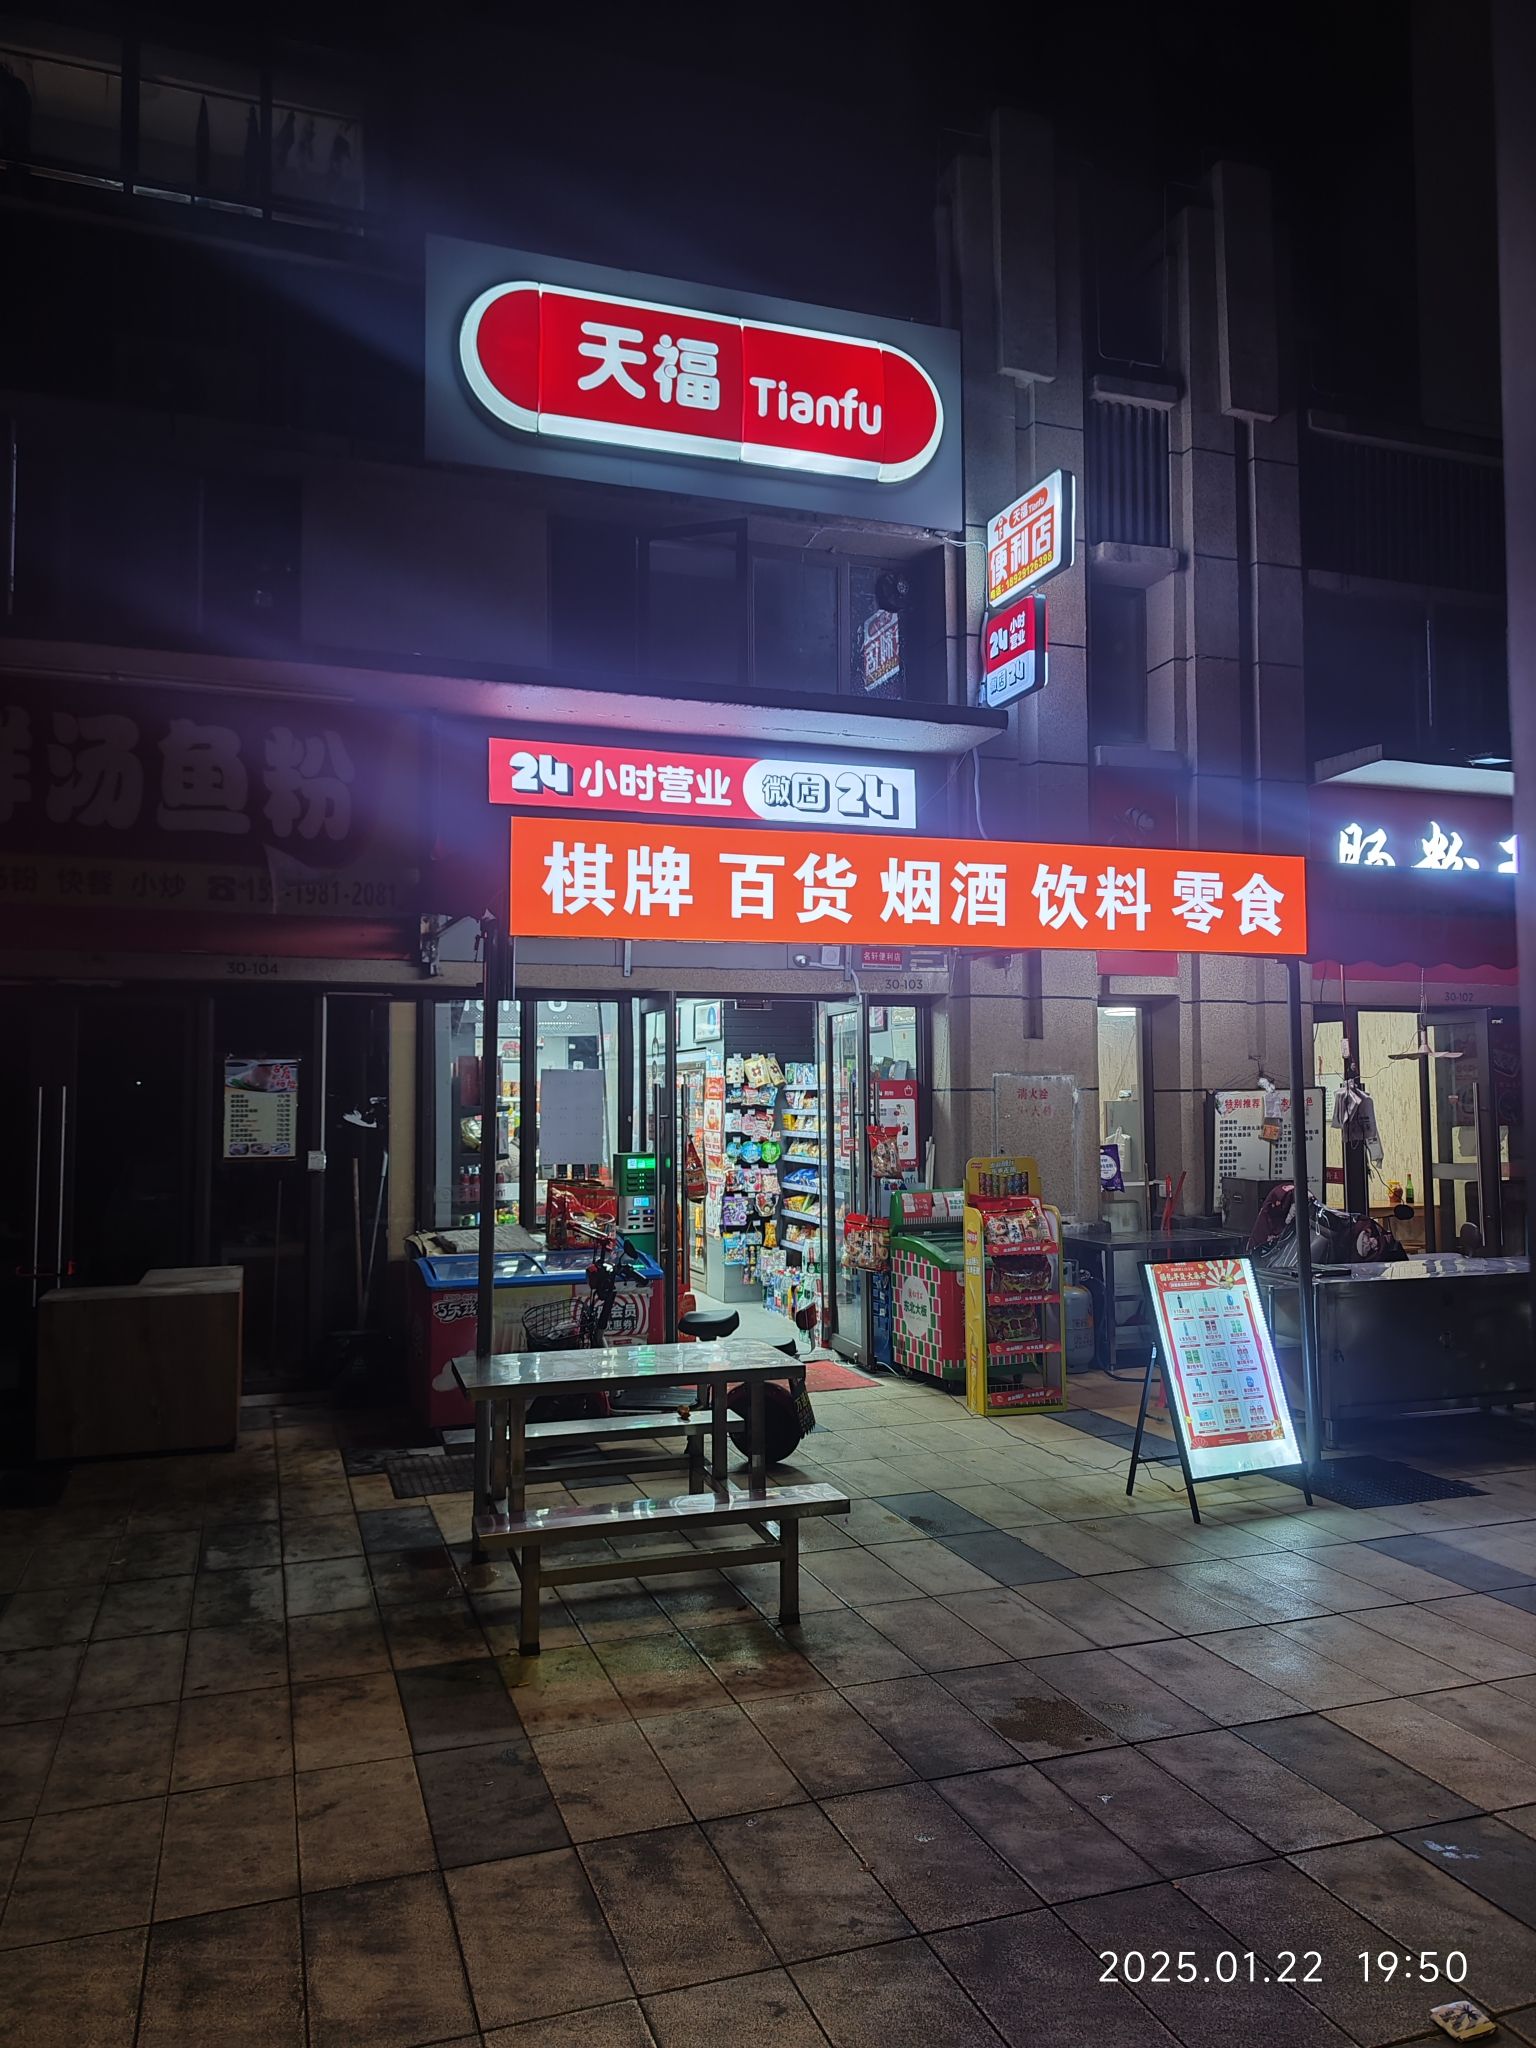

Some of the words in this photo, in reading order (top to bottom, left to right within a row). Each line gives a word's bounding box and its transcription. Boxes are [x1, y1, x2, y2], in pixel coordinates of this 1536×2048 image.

[577, 321, 720, 411] 天福
[749, 376, 882, 435] Tianfu
[990, 512, 1052, 589] 便利店
[990, 627, 1009, 659] 24
[542, 841, 694, 917] 棋牌
[719, 852, 858, 924] 百货
[880, 857, 1007, 927] 烟酒
[1031, 864, 1152, 932] 饮料
[1171, 870, 1285, 937] 零食
[226, 962, 278, 974] 30-104
[885, 979, 923, 990] 30-103
[1225, 1098, 1260, 1108] 特别推荐
[903, 1300, 928, 1317] 东北大板
